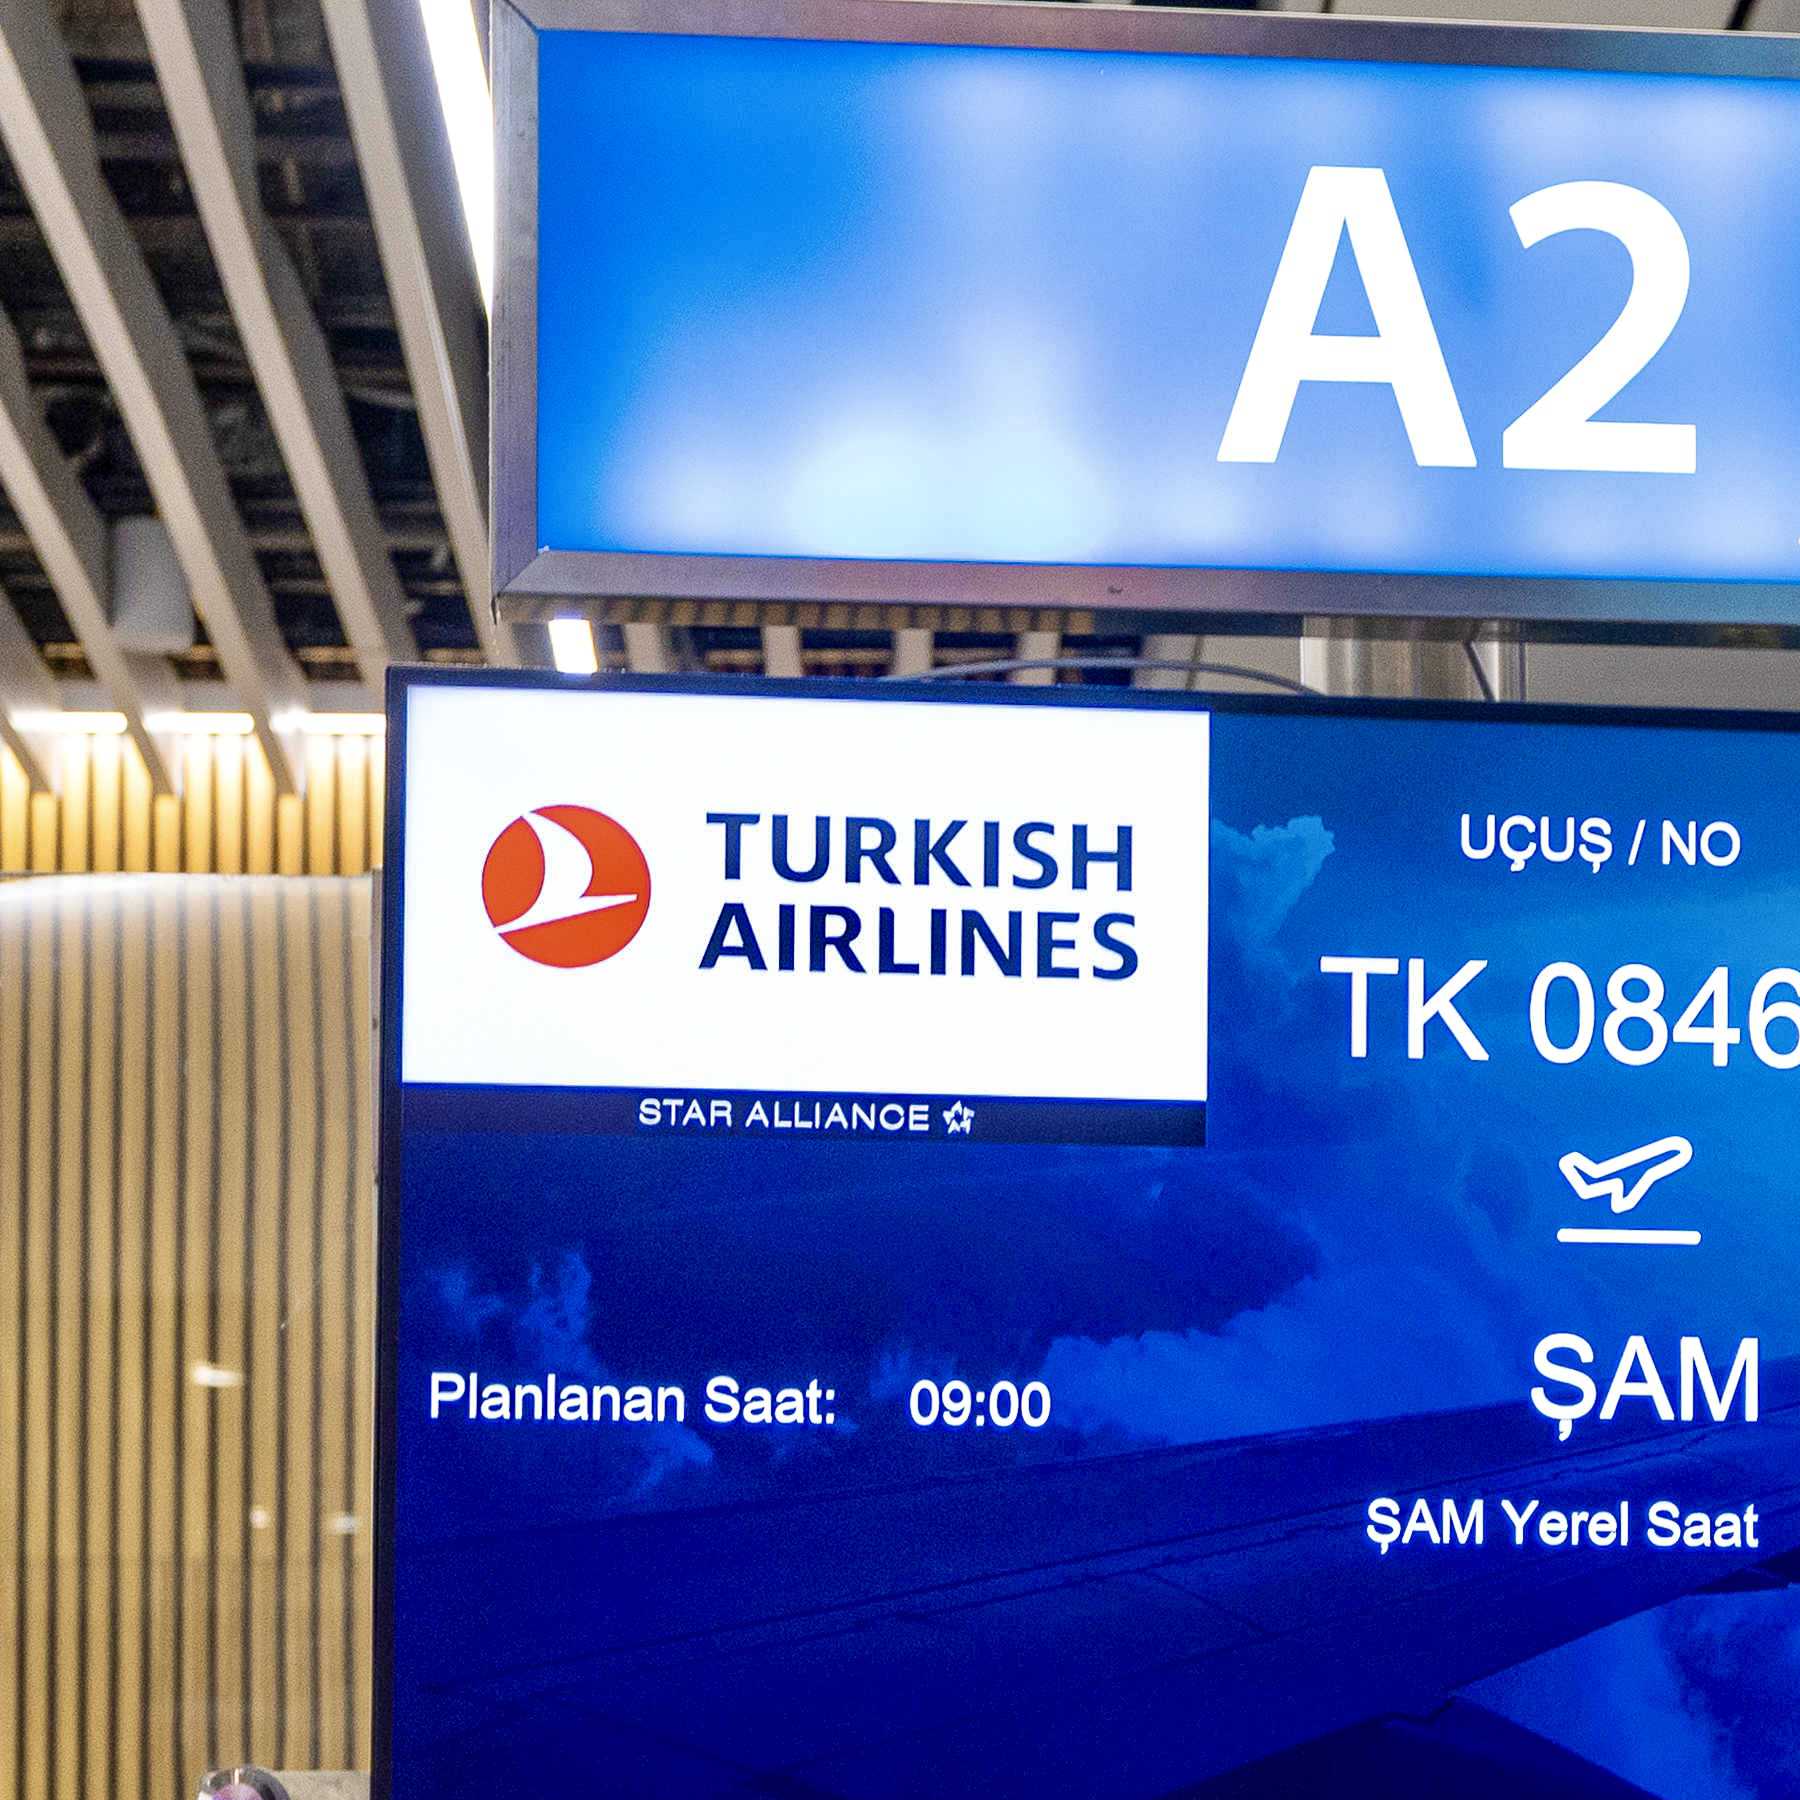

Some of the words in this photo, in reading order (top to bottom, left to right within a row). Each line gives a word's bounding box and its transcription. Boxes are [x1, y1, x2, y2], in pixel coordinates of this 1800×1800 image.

[1218, 166, 1696, 473] A2
[706, 812, 1133, 892] TURKISH
[1461, 813, 1613, 874] UÇUŞ
[1628, 819, 1646, 867] /
[1662, 820, 1741, 867] NO
[698, 902, 1138, 981] AIRLINES
[1320, 956, 1489, 1061] TK
[638, 1097, 732, 1127] STAR
[745, 1099, 930, 1132] ALLIANCE
[430, 1372, 685, 1422] Planlanan
[704, 1375, 836, 1425] Saat:
[909, 1379, 1052, 1428] 09:00
[1530, 1332, 1760, 1442] ŞAM
[1366, 1497, 1485, 1555] ŞAM
[1500, 1499, 1629, 1547] Yerel
[1647, 1500, 1760, 1549] Saat
